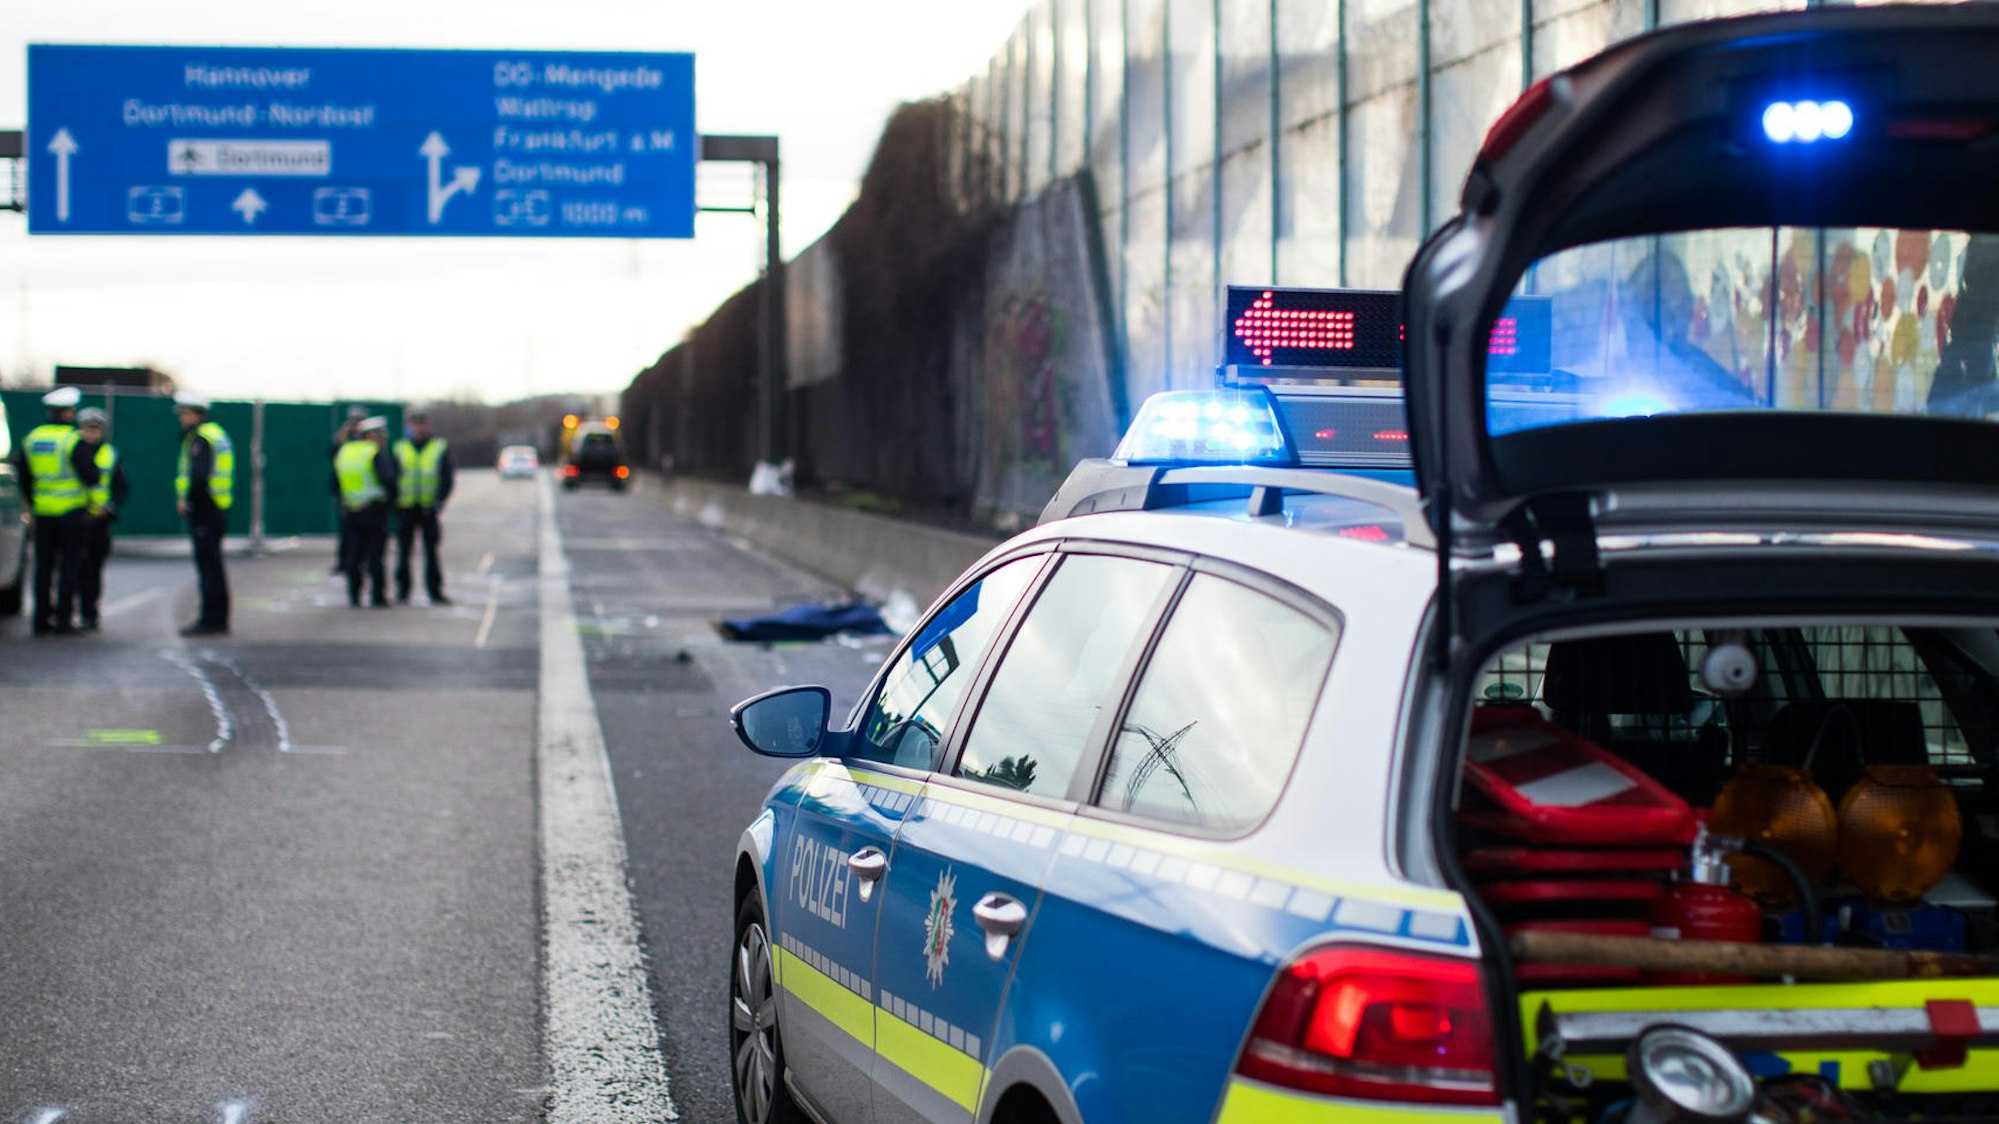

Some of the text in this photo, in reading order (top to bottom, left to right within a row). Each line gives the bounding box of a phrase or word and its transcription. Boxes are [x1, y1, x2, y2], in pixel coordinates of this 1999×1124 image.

[184, 64, 310, 87] Hannover
[494, 127, 617, 151] Frankfurt
[216, 145, 326, 170] Dortmund
[494, 159, 623, 184] Dortmund
[789, 833, 851, 930] POLIZEI
